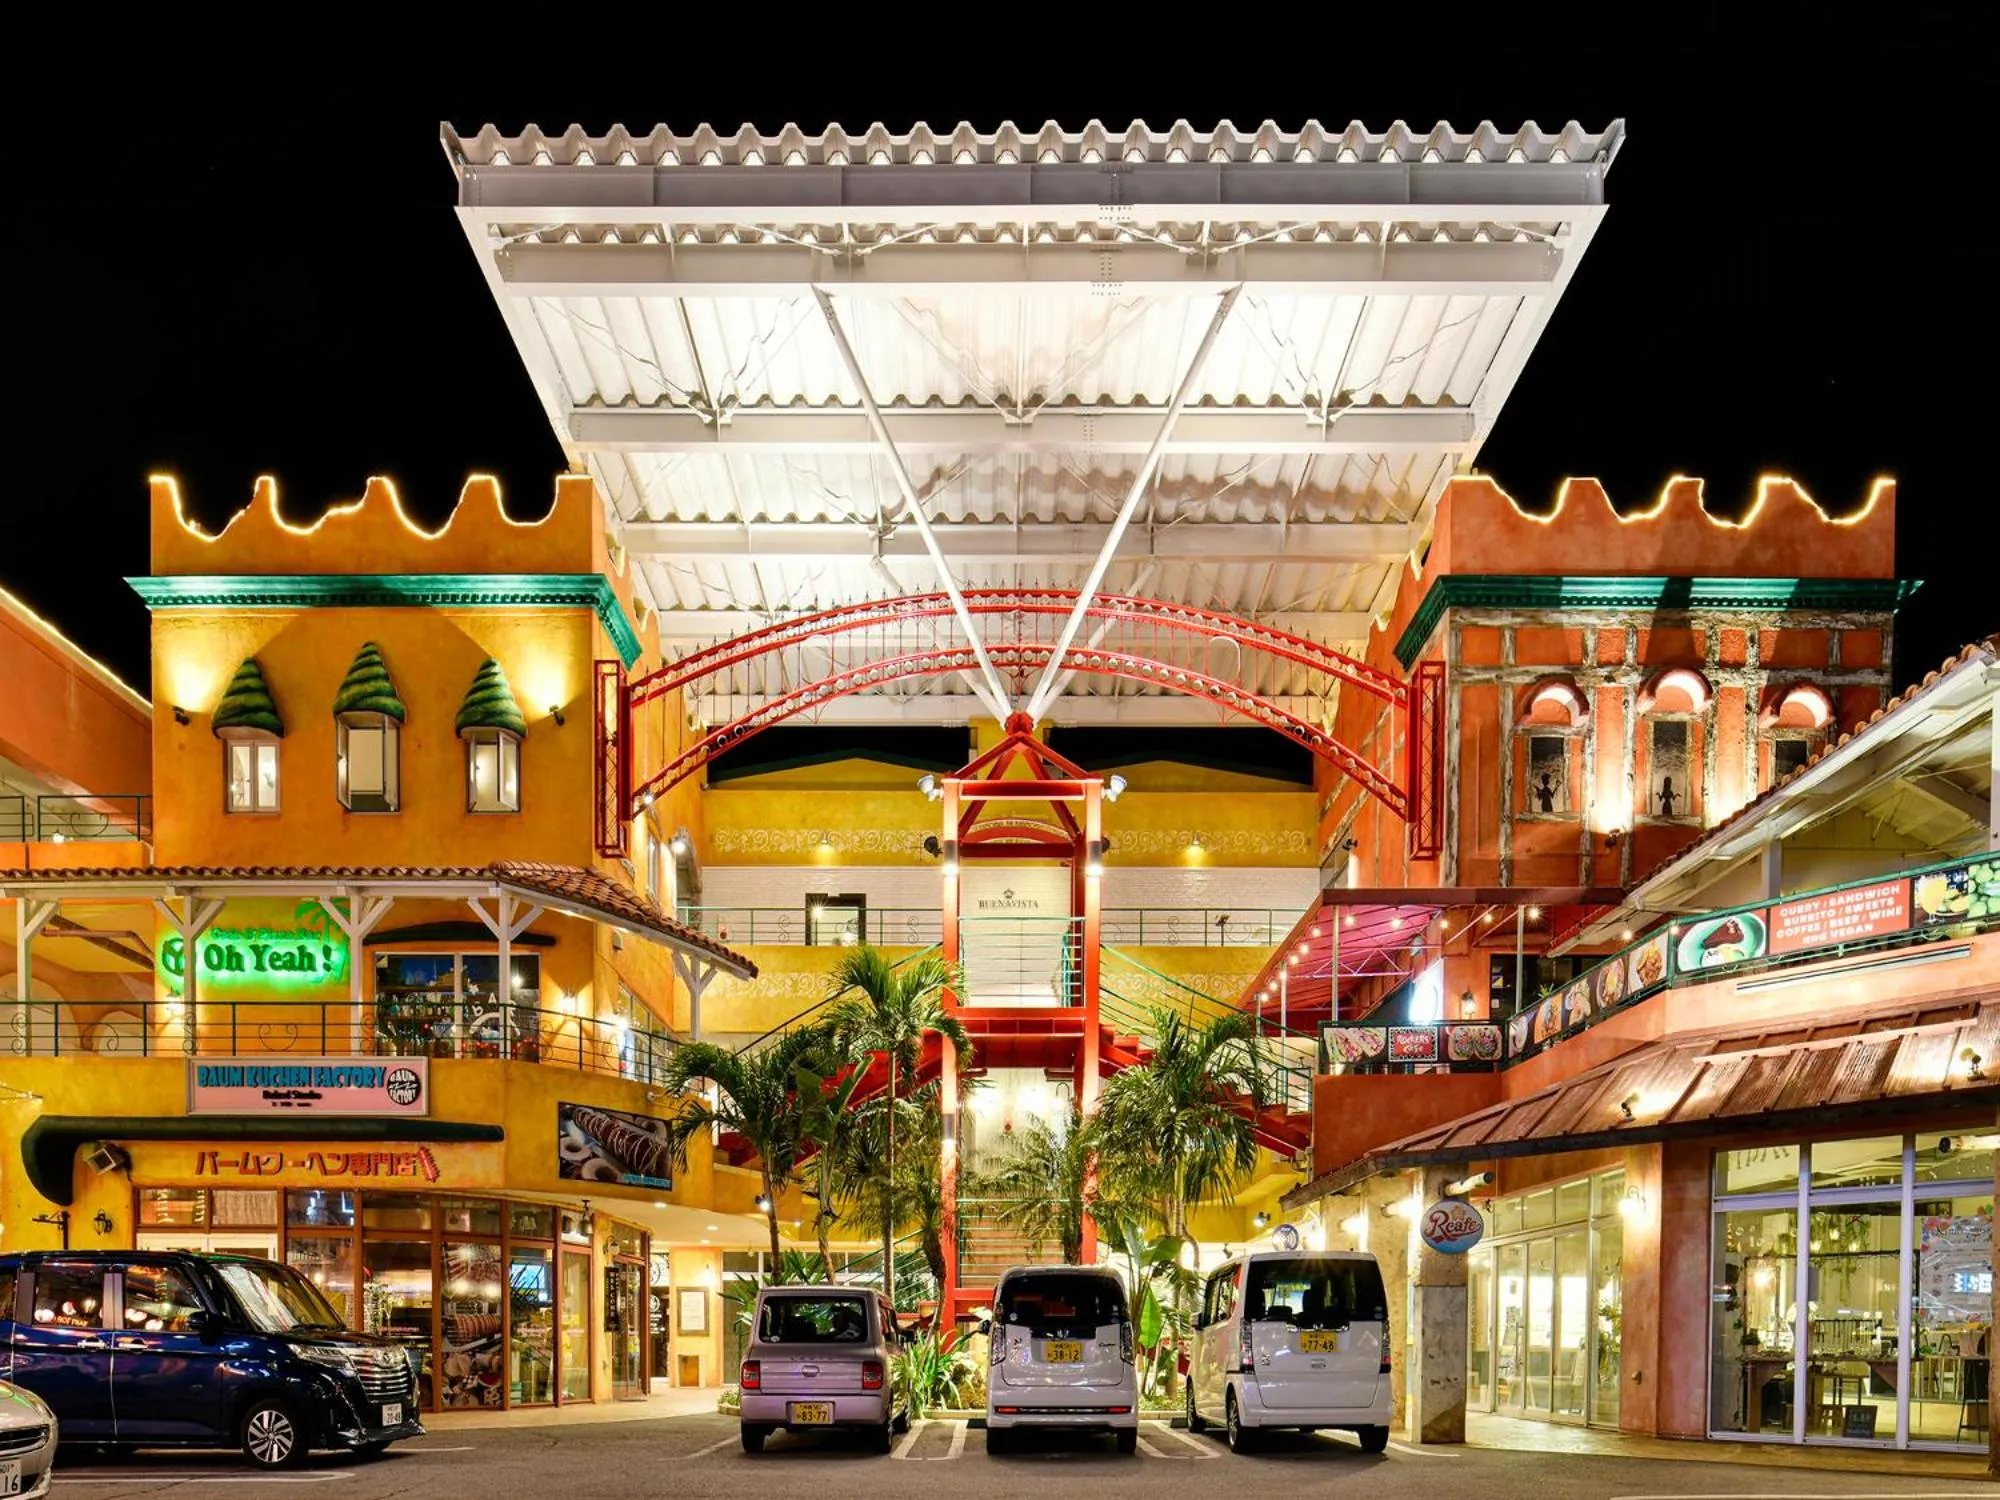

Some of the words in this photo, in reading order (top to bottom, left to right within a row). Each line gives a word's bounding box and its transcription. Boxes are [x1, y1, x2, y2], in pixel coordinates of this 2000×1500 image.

[978, 899, 1039, 909] BUENAVISTA
[1779, 901, 1819, 917] CURRY
[1829, 885, 1901, 907] SANDWICH
[1784, 908, 1836, 927] BURRITO
[1845, 897, 1895, 914] SWEETS
[1776, 921, 1821, 938] COFFEE
[1829, 914, 1860, 928] BEER
[1869, 905, 1903, 920] WINE
[1830, 923, 1874, 938] VEGAN
[203, 944, 245, 972] Oh
[197, 1066, 244, 1088] BAUM
[246, 1066, 313, 1088] KUCHEN
[314, 1066, 387, 1088] FACTORY
[390, 1070, 416, 1082] BAUM
